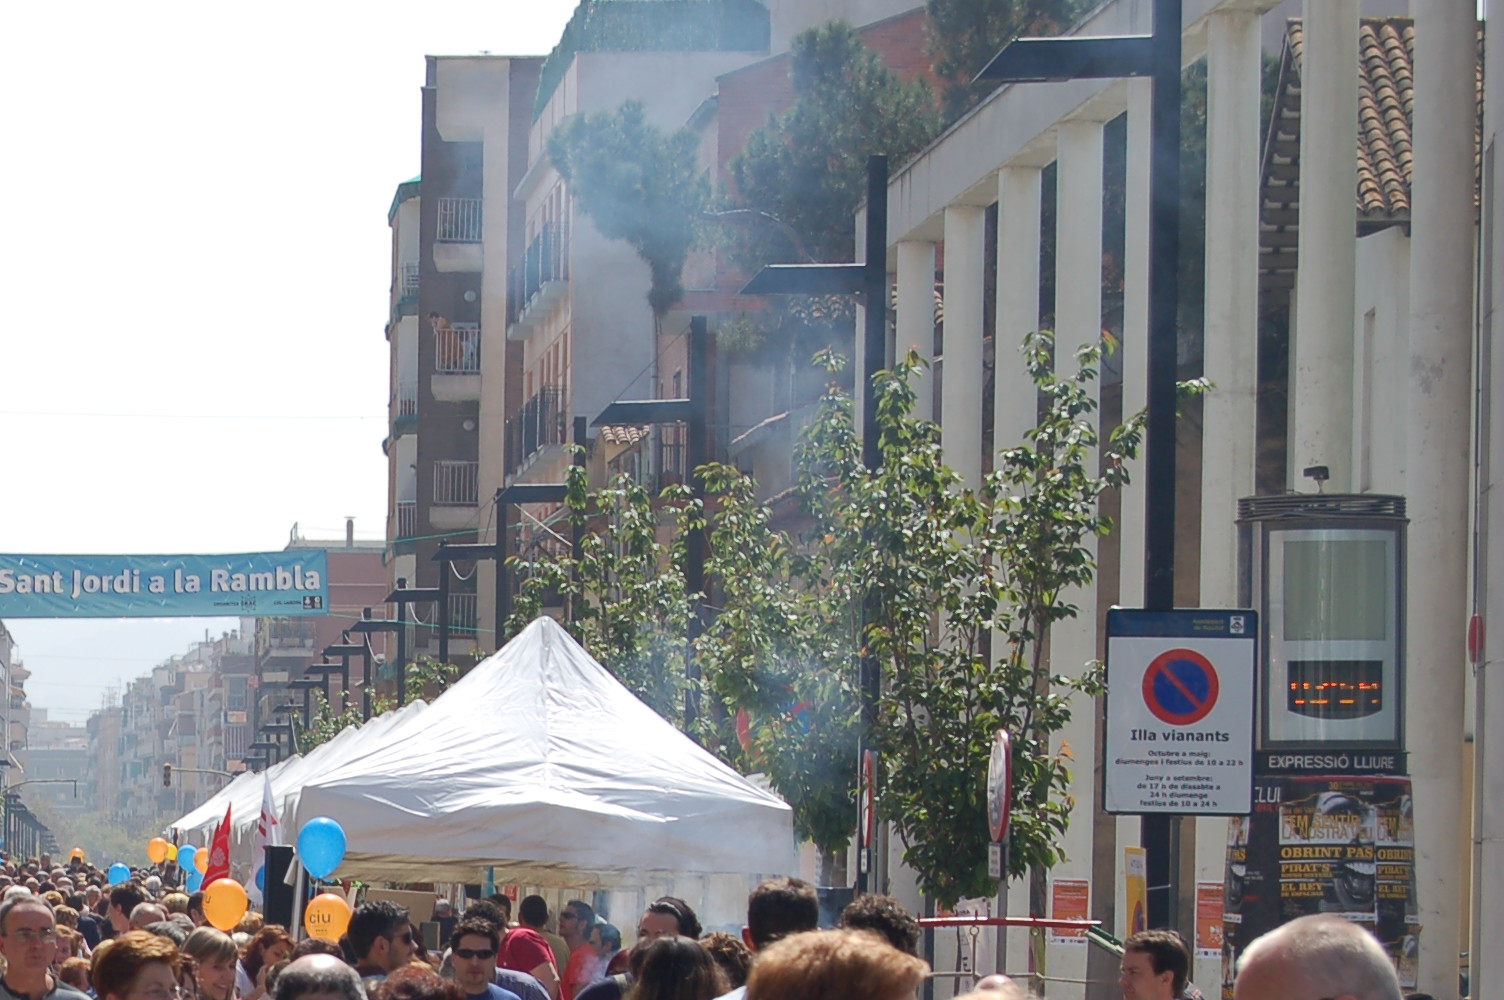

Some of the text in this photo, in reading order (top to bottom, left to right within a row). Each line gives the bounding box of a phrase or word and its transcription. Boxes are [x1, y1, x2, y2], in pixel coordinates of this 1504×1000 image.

[71, 567, 141, 600] Jordi
[148, 575, 166, 594] a
[175, 566, 201, 594] la
[211, 564, 321, 593] Rambla
[1130, 729, 1230, 742] Illa vianants
[1268, 753, 1395, 769] EXPRESSIÓ LLIURE
[1280, 846, 1374, 859] OBRINT PAS
[1280, 882, 1325, 892] EL REY
[309, 909, 331, 925] ciu
